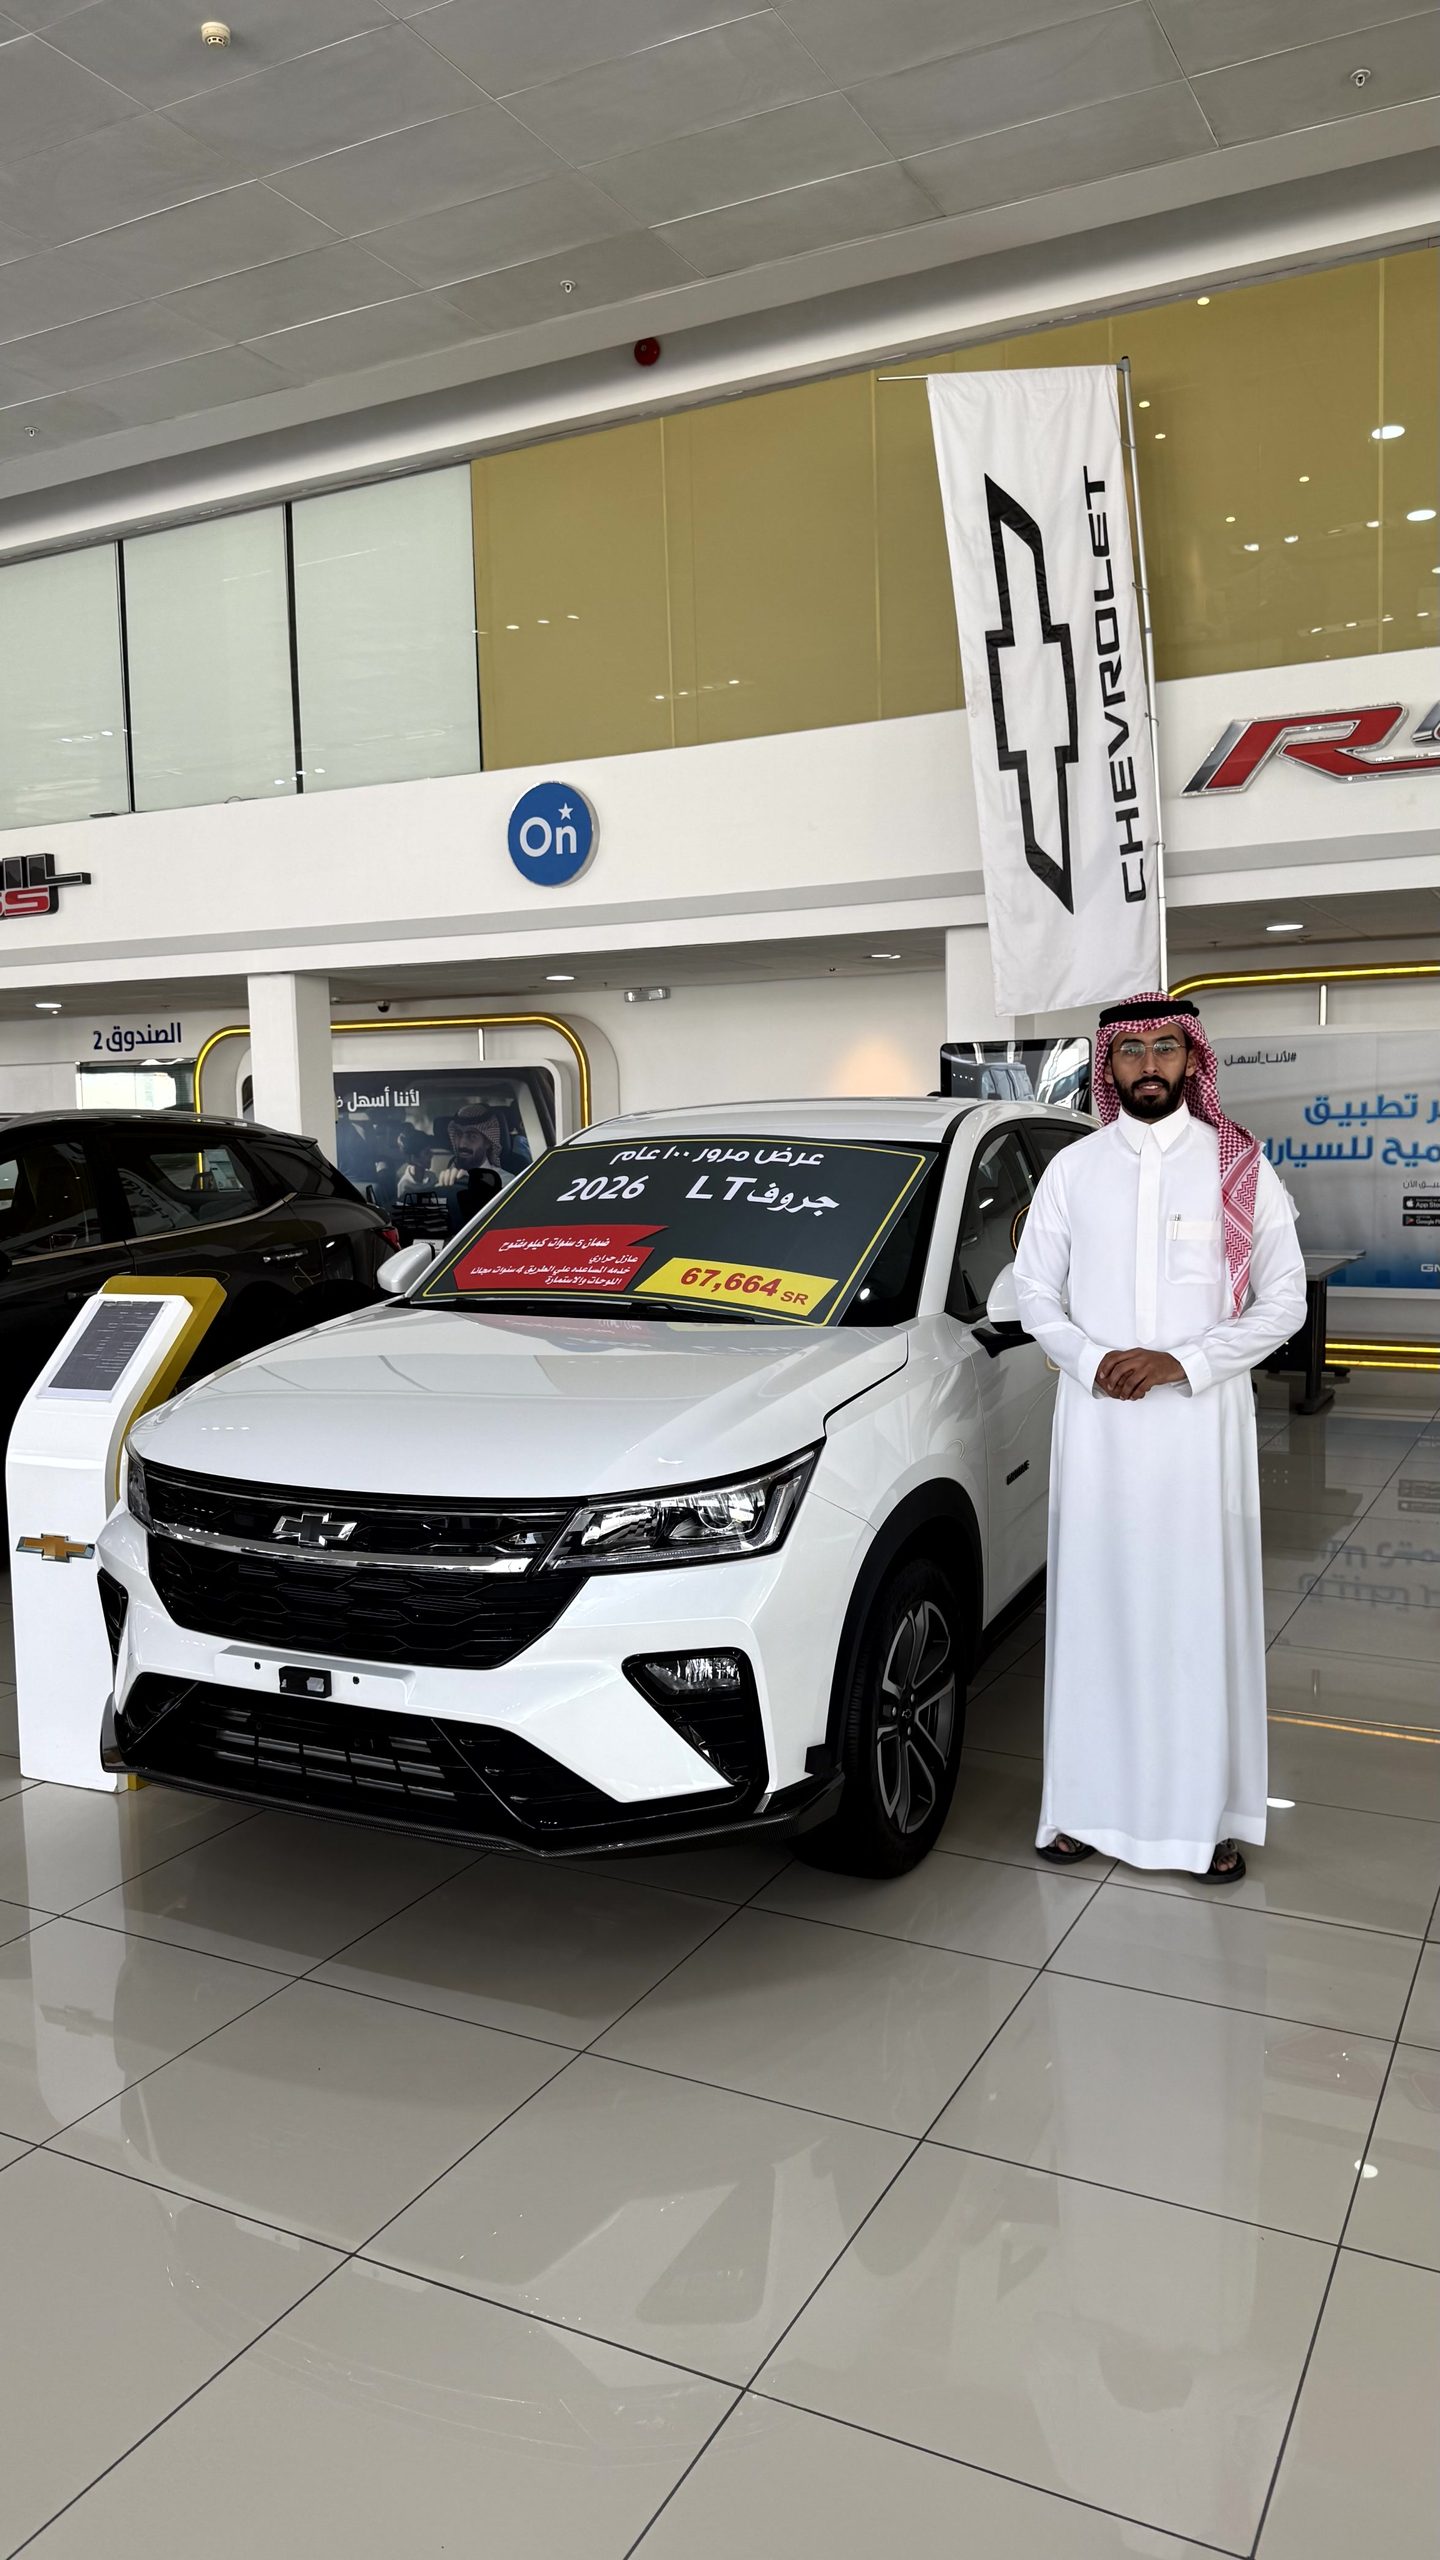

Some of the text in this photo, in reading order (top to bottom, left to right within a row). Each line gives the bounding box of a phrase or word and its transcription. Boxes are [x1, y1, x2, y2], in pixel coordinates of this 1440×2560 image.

[1083, 465, 1146, 903] CHEVROLET
[1180, 701, 1440, 798] R
[519, 816, 577, 858] On
[93, 1022, 182, 1052] الصندوق 2
[347, 1086, 390, 1112] أسهل
[393, 1088, 420, 1107] لأننا
[1304, 1093, 1419, 1127] تطبيق
[609, 1146, 660, 1165] عام
[692, 1147, 750, 1163] مرور
[754, 1146, 825, 1166] عرض
[1264, 1135, 1440, 1168] ميح للسيارا
[556, 1174, 840, 1217] جروف LT 2026
[547, 1237, 576, 1249] سنوات
[575, 1239, 586, 1248] 5
[680, 1267, 809, 1306] 67,664 SR
